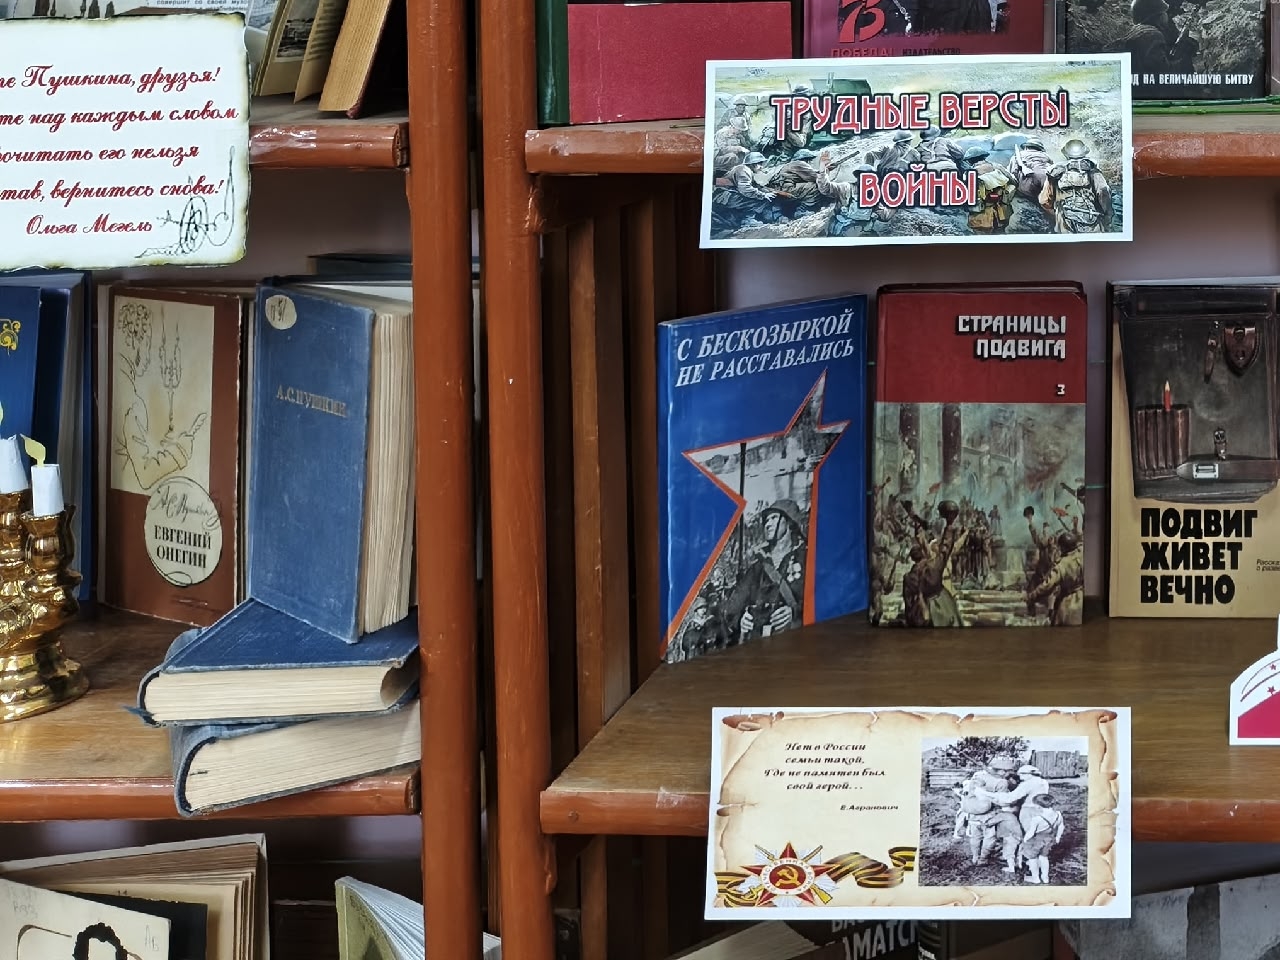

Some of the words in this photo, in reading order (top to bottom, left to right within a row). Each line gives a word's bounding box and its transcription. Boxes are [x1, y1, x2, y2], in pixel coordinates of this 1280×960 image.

[21, 65, 135, 96] Пушкина,
[137, 66, 221, 94] друзья!
[1159, 71, 1221, 85] ВЕЛИЧАЙШУЮ
[1225, 74, 1254, 85] БИТВУ
[29, 110, 66, 132] над
[71, 107, 164, 131] каждым
[169, 100, 239, 122] словом
[770, 93, 930, 140] ТРУДНЫЕ
[940, 91, 1069, 129] ВЕРСТЫ
[98, 148, 126, 162] его
[131, 145, 200, 167] нельзя
[50, 179, 155, 207] вернитесь
[159, 175, 224, 197] снова!
[858, 164, 978, 208] ВОЙНЫ
[25, 214, 77, 235] Ольга
[677, 339, 692, 361] С
[697, 308, 855, 359] БЕСКОЗЫРКОЙ
[957, 314, 1067, 336] СТРАНИЦЫ
[709, 339, 855, 382] РАССТАВАЛИСЬ
[974, 337, 1067, 360] ПОДВИГА
[154, 524, 212, 551] ЕВГЕНИЙ
[1140, 508, 1258, 539] ПОДВИГ
[156, 544, 207, 569] ОНЕГИН
[1140, 542, 1243, 572] ЖИВЕТ
[1140, 573, 1236, 606] ВЕЧНО
